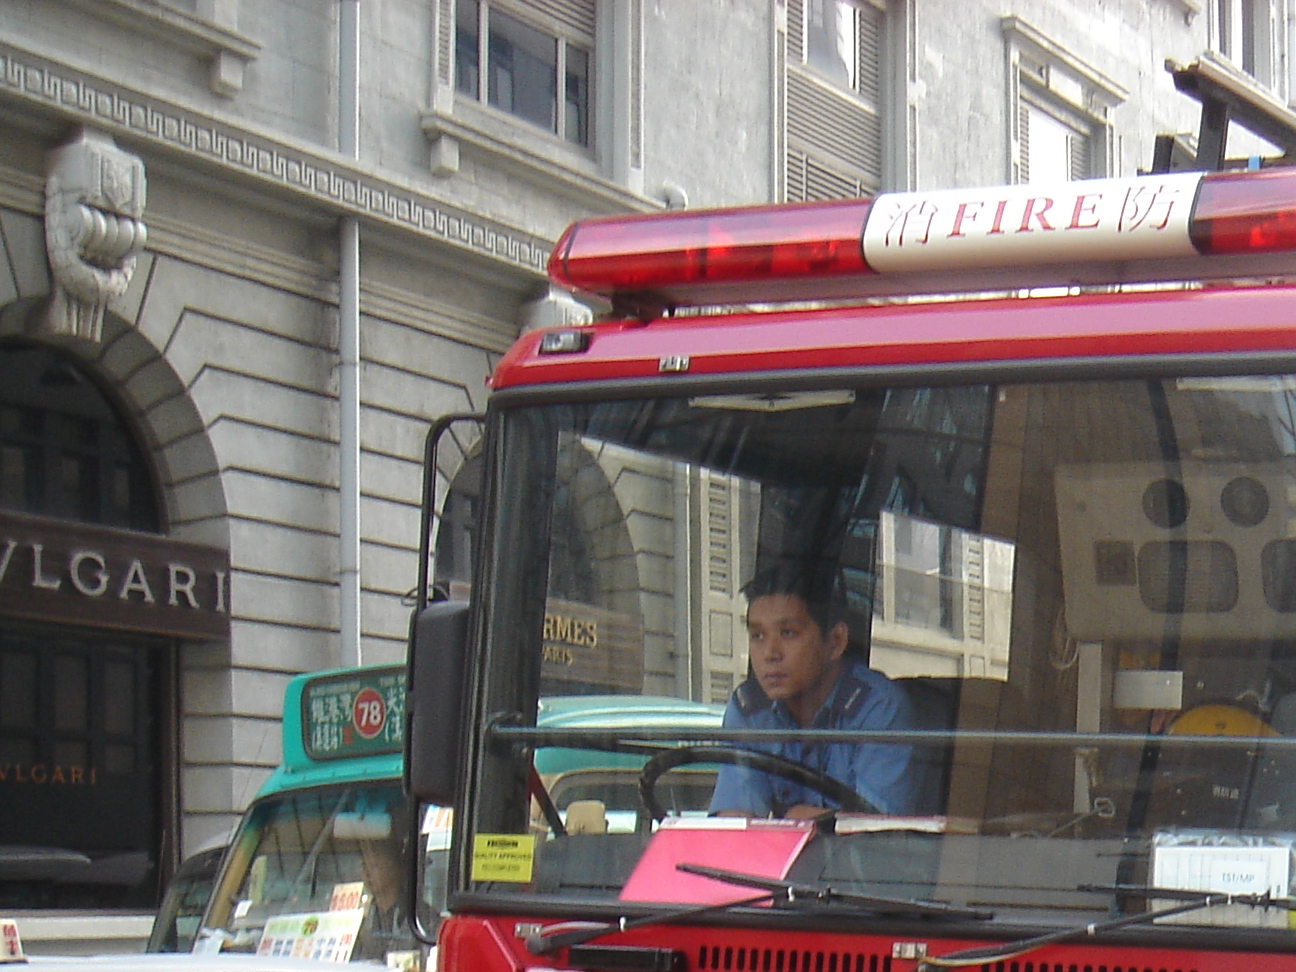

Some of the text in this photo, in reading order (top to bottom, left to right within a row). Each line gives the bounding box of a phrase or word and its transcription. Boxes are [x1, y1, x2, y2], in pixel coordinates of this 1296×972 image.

[884, 184, 1181, 247] 消 FIRE 防
[358, 701, 382, 727] 78
